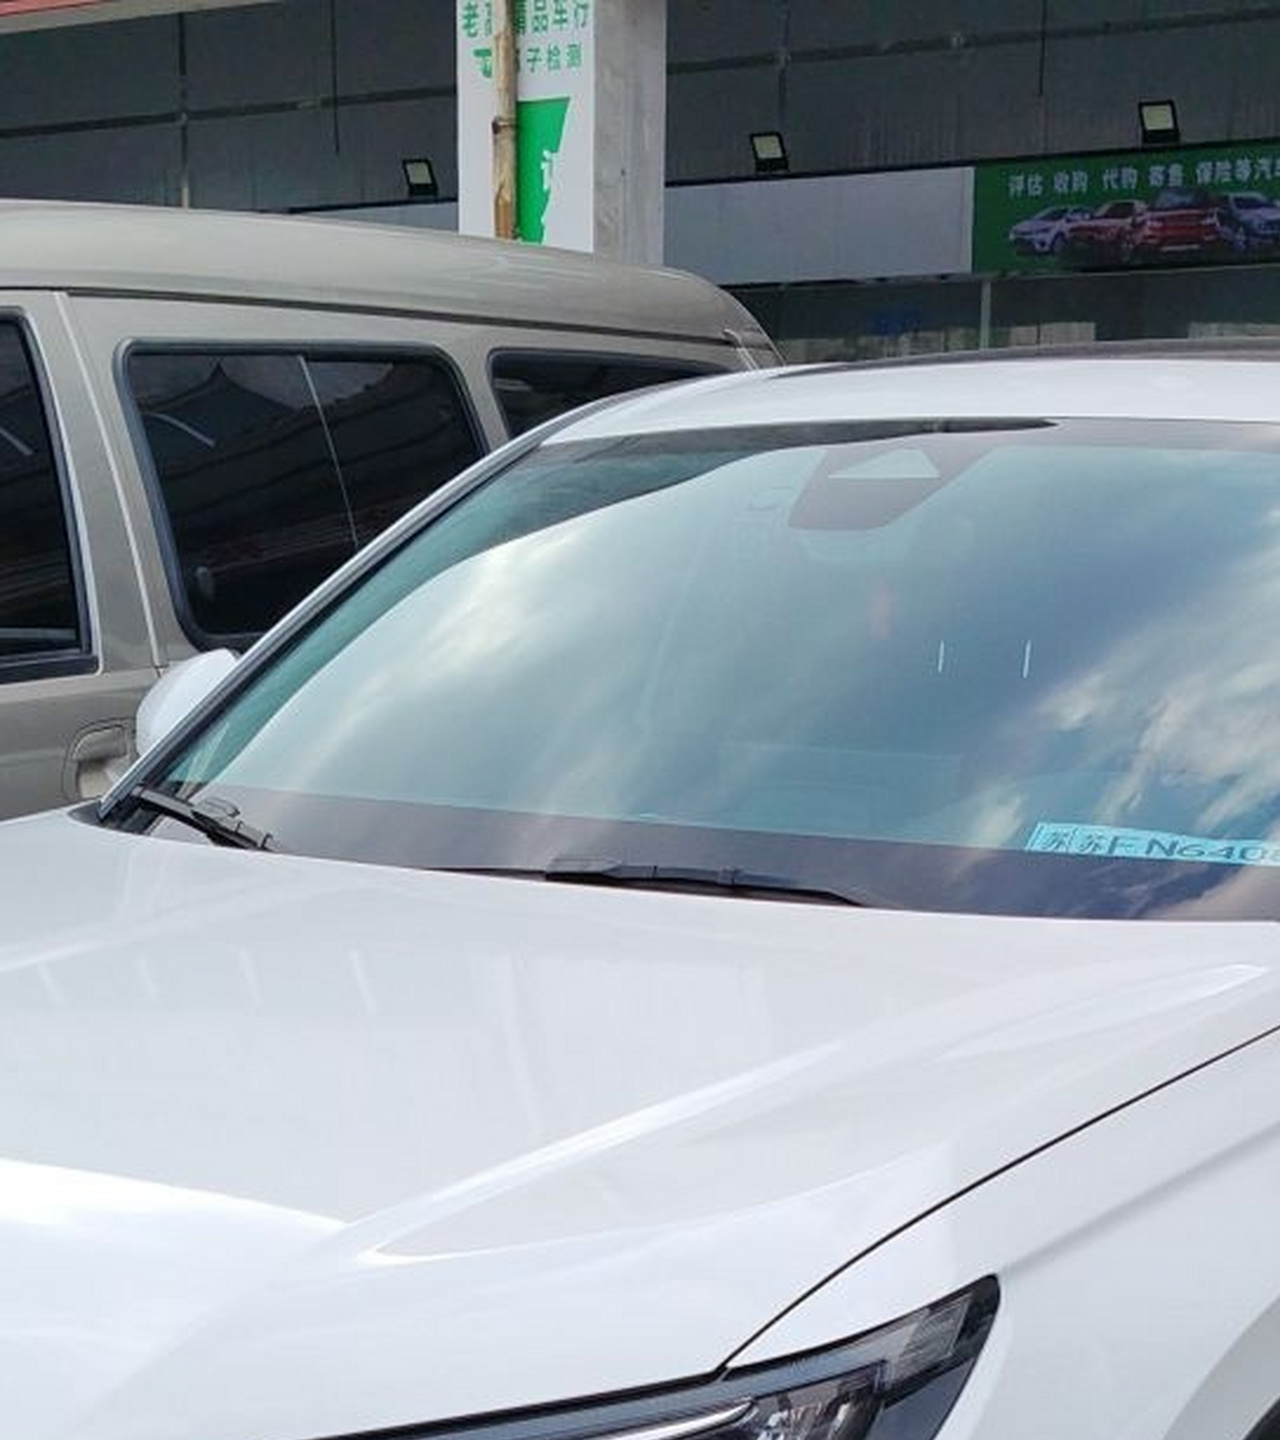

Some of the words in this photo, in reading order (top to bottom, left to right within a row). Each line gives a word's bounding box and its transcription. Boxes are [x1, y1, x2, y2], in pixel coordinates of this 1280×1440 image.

[1007, 173, 1043, 198] 评估
[1053, 171, 1088, 194] 收购
[1102, 166, 1138, 191] 代购
